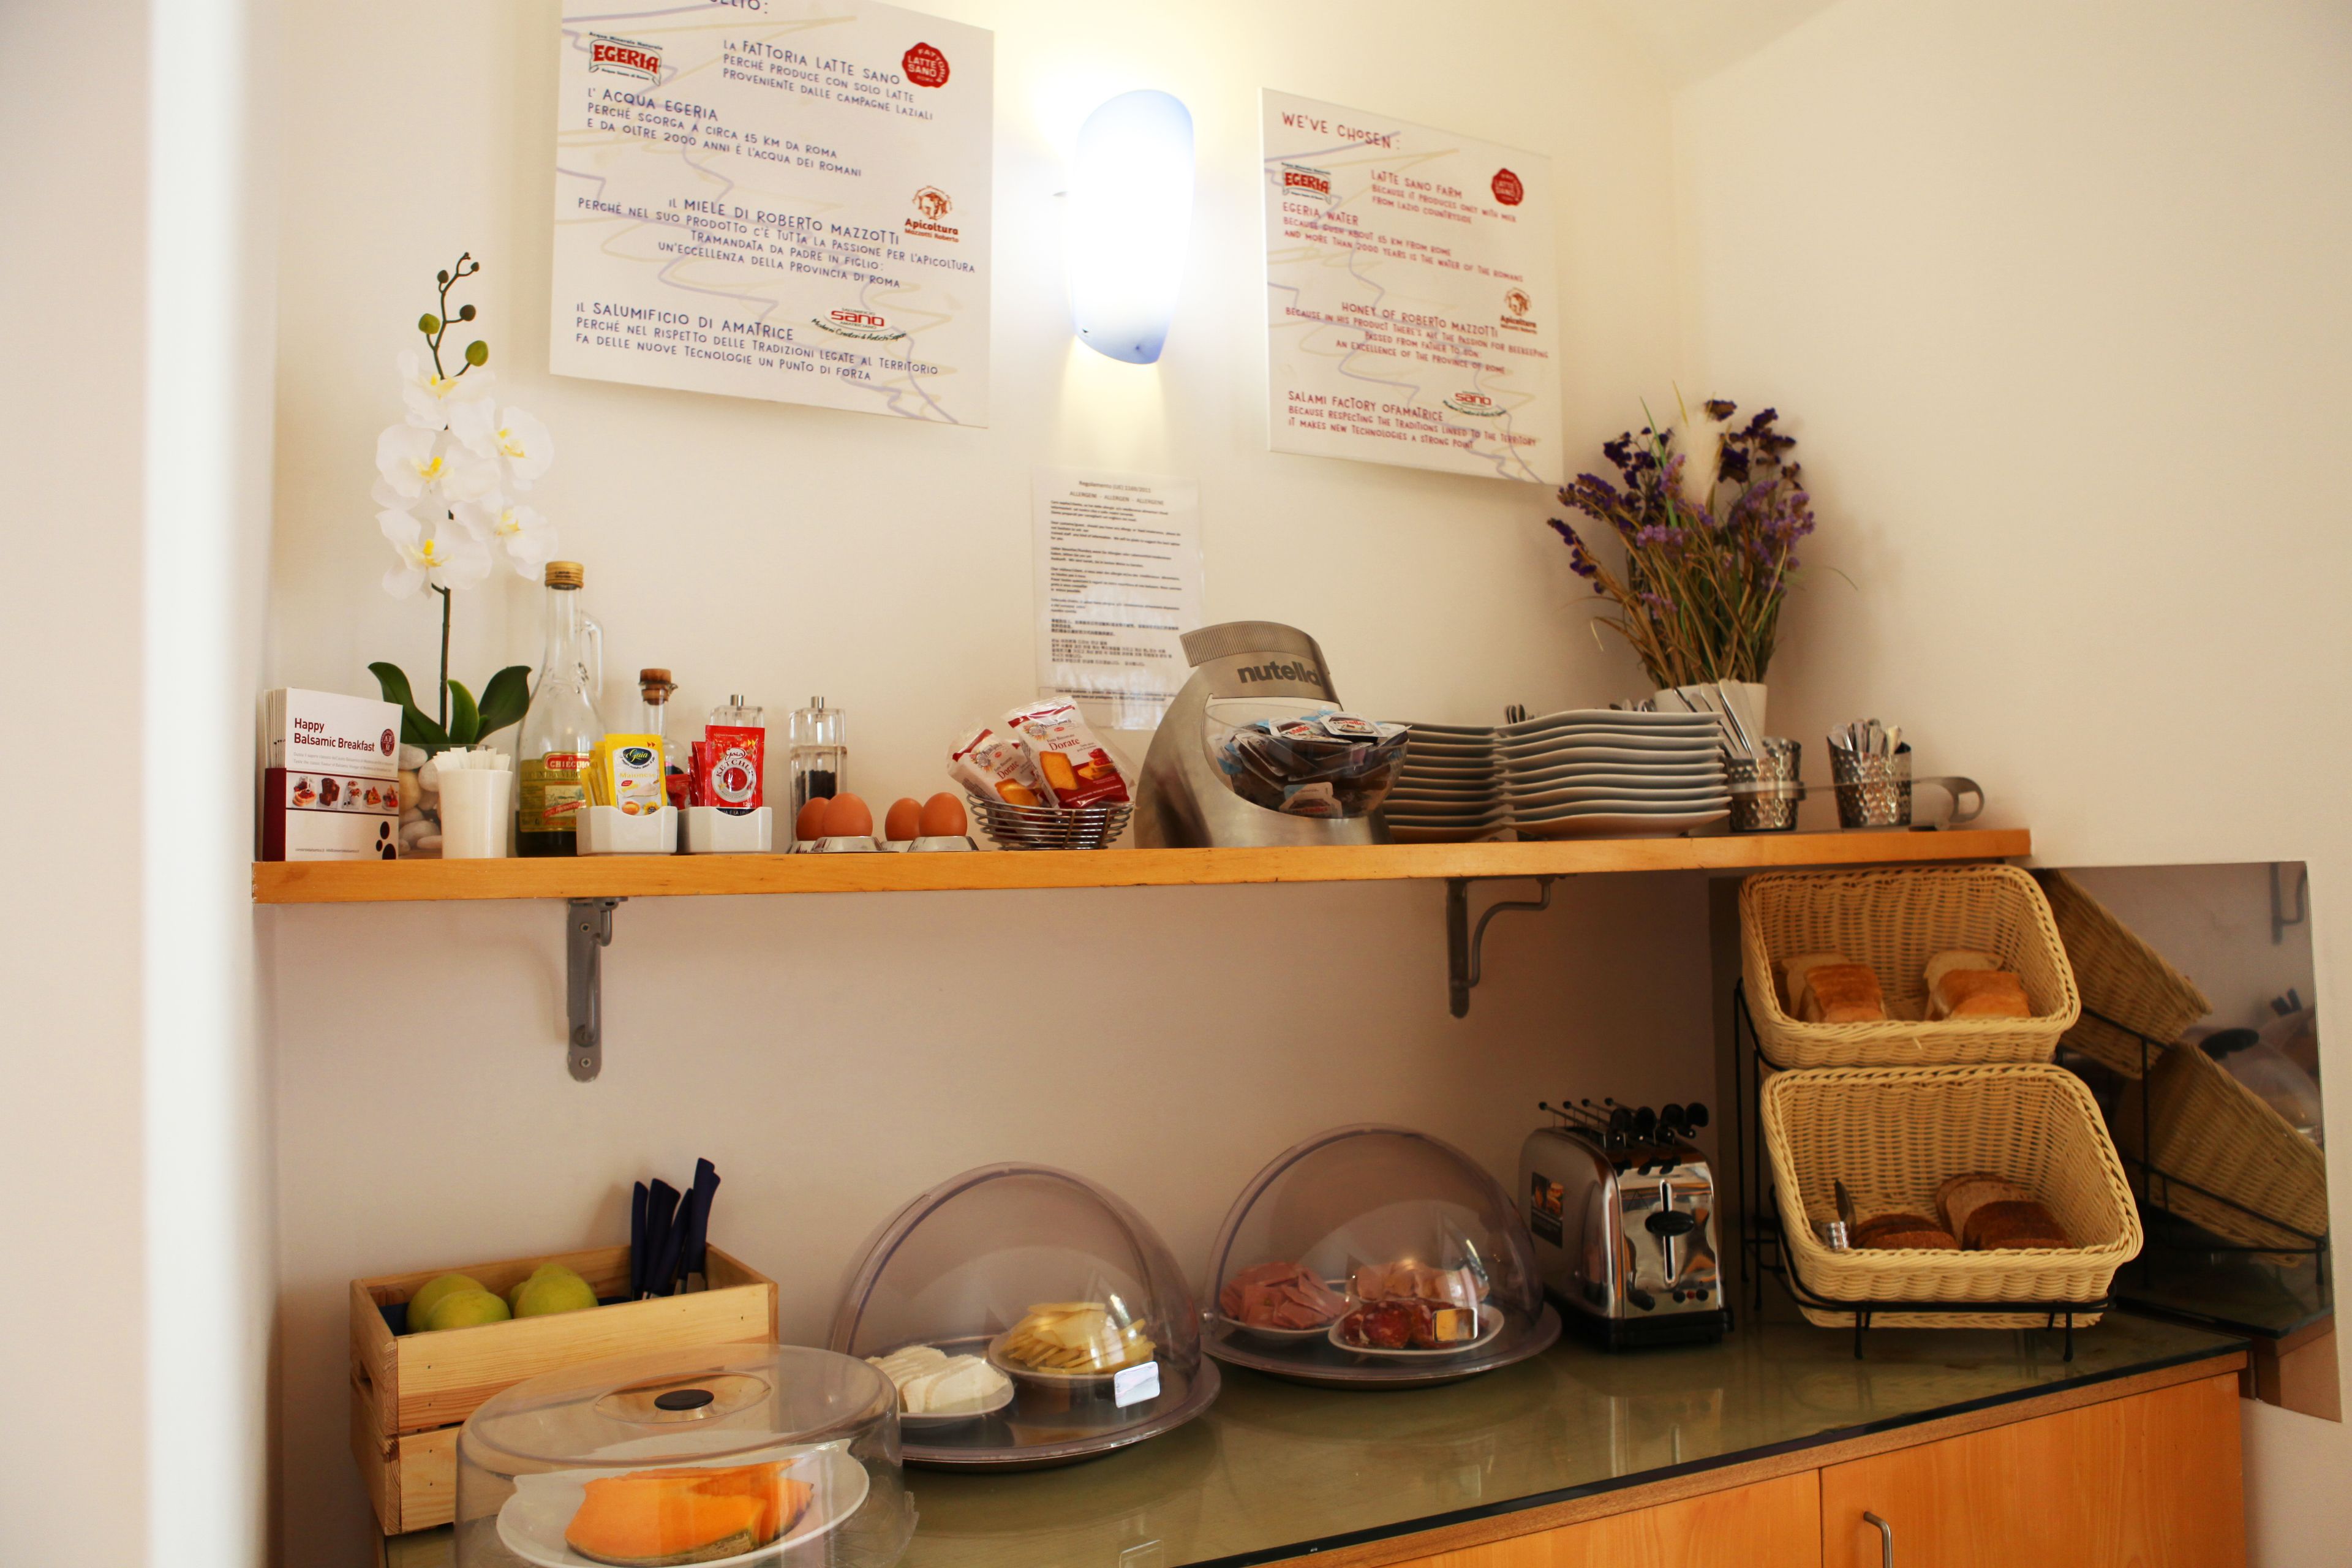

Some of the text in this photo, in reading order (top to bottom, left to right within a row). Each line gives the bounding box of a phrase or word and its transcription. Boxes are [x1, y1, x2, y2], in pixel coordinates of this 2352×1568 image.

[593, 44, 659, 74] EGERIA
[724, 40, 900, 85] LA FATTORIA LATTE SANO
[908, 55, 937, 69] LATTE
[908, 64, 937, 77] SANO
[723, 53, 913, 103] PERCHÉ PRODUCE CON SOLO LATTE
[602, 89, 656, 110] ACQUA
[665, 100, 718, 122] EGERIA
[723, 68, 932, 120] PROVENIENTE DALLE CAMPAGNE LAZIALI
[587, 102, 837, 159] PERCHÉ SGORGA A CIRCA 15 KM DA ROMA
[1282, 111, 1329, 134] WE'VE
[587, 118, 593, 128] E
[600, 121, 616, 132] DA
[622, 125, 657, 140] OLTRE
[664, 132, 696, 146] 2000
[703, 141, 730, 152] ANNI
[748, 148, 790, 164] L'ACQUA
[797, 157, 813, 168] DEI
[819, 160, 861, 176] ROMANI
[1284, 172, 1329, 194] EGERIA
[1372, 170, 1461, 198] LATTE SANO FARM
[669, 198, 899, 246] IL MIELE DI ROBERTO MAZZOTTI
[905, 218, 959, 235] Apicoltura
[1283, 202, 1358, 225] EGERIA WATER
[628, 207, 649, 219] NEL
[656, 211, 680, 223] SUO
[686, 215, 747, 233] PRODOTTO
[777, 229, 807, 244] TUTTA
[832, 239, 881, 257] PASSIONE
[887, 249, 905, 261] PER
[911, 254, 974, 273] L'APICOLTURA
[691, 230, 763, 252] TRAMANDATA
[770, 244, 783, 255] DA
[790, 247, 822, 261] PADRE
[829, 255, 839, 264] IN
[658, 242, 900, 288] UN'ECCELLENZA DELLA PROVINCIA DI ROMA
[576, 302, 793, 341] IL SALUMIFICIO DI AMATRICE
[831, 310, 884, 326] sano
[1342, 303, 1376, 316] HONEY
[1382, 309, 1396, 320] OF
[1402, 312, 1446, 328] ROBERTO
[1451, 322, 1498, 336] MAZZOTTI
[576, 317, 938, 375] PERCHÉ NEL RISPETTO DELLE TRADIZIONI LEGATE AL TERRITORIO
[576, 333, 871, 380] FA DELLE NUOVE TECNOLOGIE UN PUNTO DI FORZA
[1351, 342, 1396, 356] EXCELLENCE
[1289, 391, 1326, 404] SALAMI
[1332, 396, 1376, 411] FACTORY
[1382, 404, 1442, 421] OFAMATRICE
[1289, 405, 1323, 417] BECAUSE
[1329, 410, 1373, 423] RESPECTING
[1396, 419, 1437, 432] TRADITIONS
[1300, 420, 1325, 429] MAKES
[1352, 425, 1407, 440] TECHNOLOGIES
[1421, 435, 1449, 445] STRONG
[1237, 661, 1322, 687] nutella
[295, 717, 325, 733] Happy
[294, 733, 375, 752] Balsamic Breakfast
[626, 748, 648, 763] Gaia
[1049, 738, 1080, 751] Dorate
